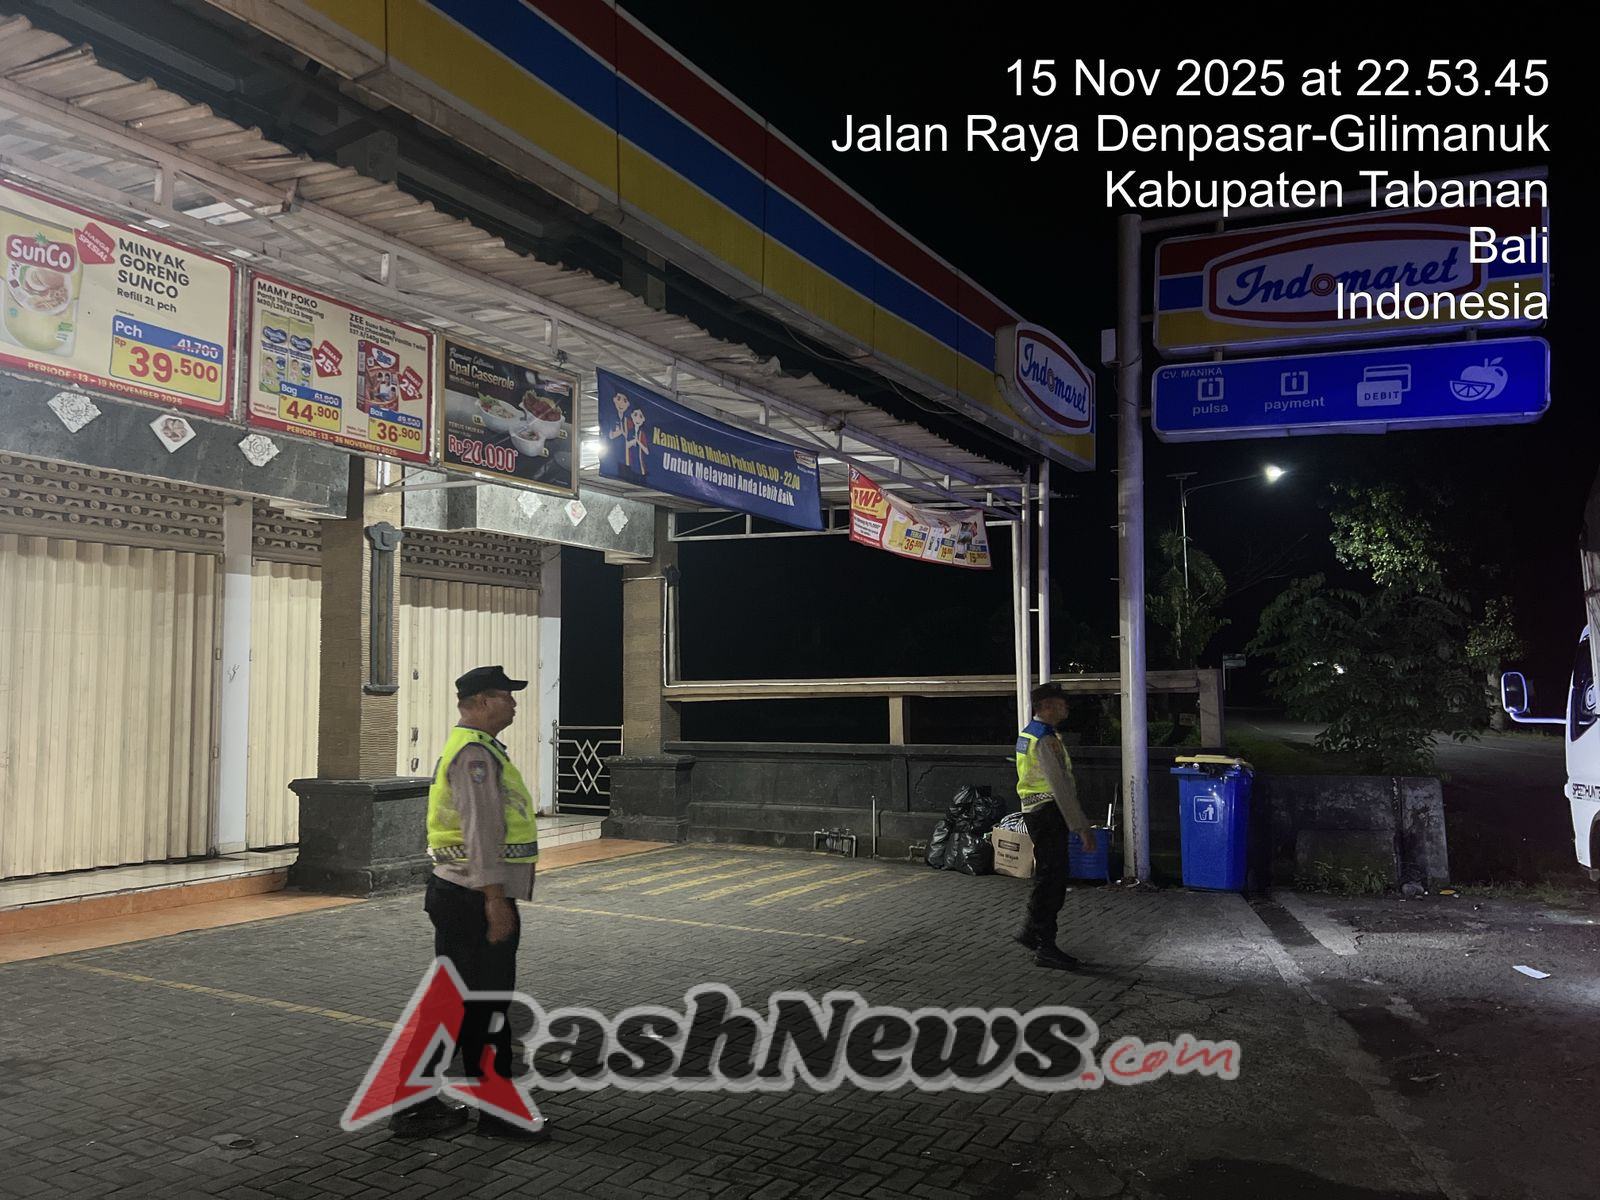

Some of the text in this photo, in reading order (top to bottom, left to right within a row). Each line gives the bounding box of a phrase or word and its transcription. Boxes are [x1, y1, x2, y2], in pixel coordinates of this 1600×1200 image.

[11, 238, 71, 269] SunCo
[79, 233, 108, 262] SPESIAL
[118, 237, 186, 271] MINYAK
[118, 269, 179, 300] SUNCO
[119, 254, 190, 287] GORENG
[1227, 246, 1459, 307] Indomaret
[117, 287, 143, 303] Refill
[157, 299, 178, 313] pch
[257, 281, 318, 309] MAMY POKO
[349, 312, 364, 325] ZEE
[115, 320, 219, 360] Pch 41.700
[128, 346, 219, 384] 39.500
[315, 353, 339, 376] 25%
[449, 358, 470, 376] Opal
[470, 366, 515, 390] Casserole
[1021, 343, 1087, 414] Indomaret
[1181, 367, 1223, 378] MANIKA
[28, 361, 71, 378] PERIODE
[78, 372, 89, 383] 13
[109, 380, 160, 400] NOVEMBER
[281, 384, 298, 397] Bag
[399, 378, 420, 399] 25%
[286, 400, 339, 422] 44.900
[1192, 396, 1326, 417] pulsa payment
[1363, 391, 1401, 402] DEBIT
[286, 424, 317, 438] PERIODE
[344, 437, 381, 452] NOVEMBER
[377, 422, 421, 443] 36.900
[652, 426, 679, 451] Kami
[680, 436, 706, 459] Buka
[705, 445, 731, 468] Mulai
[731, 454, 757, 475] Pukul
[662, 452, 795, 507] Untuk Melayani Anda Lebih Baik
